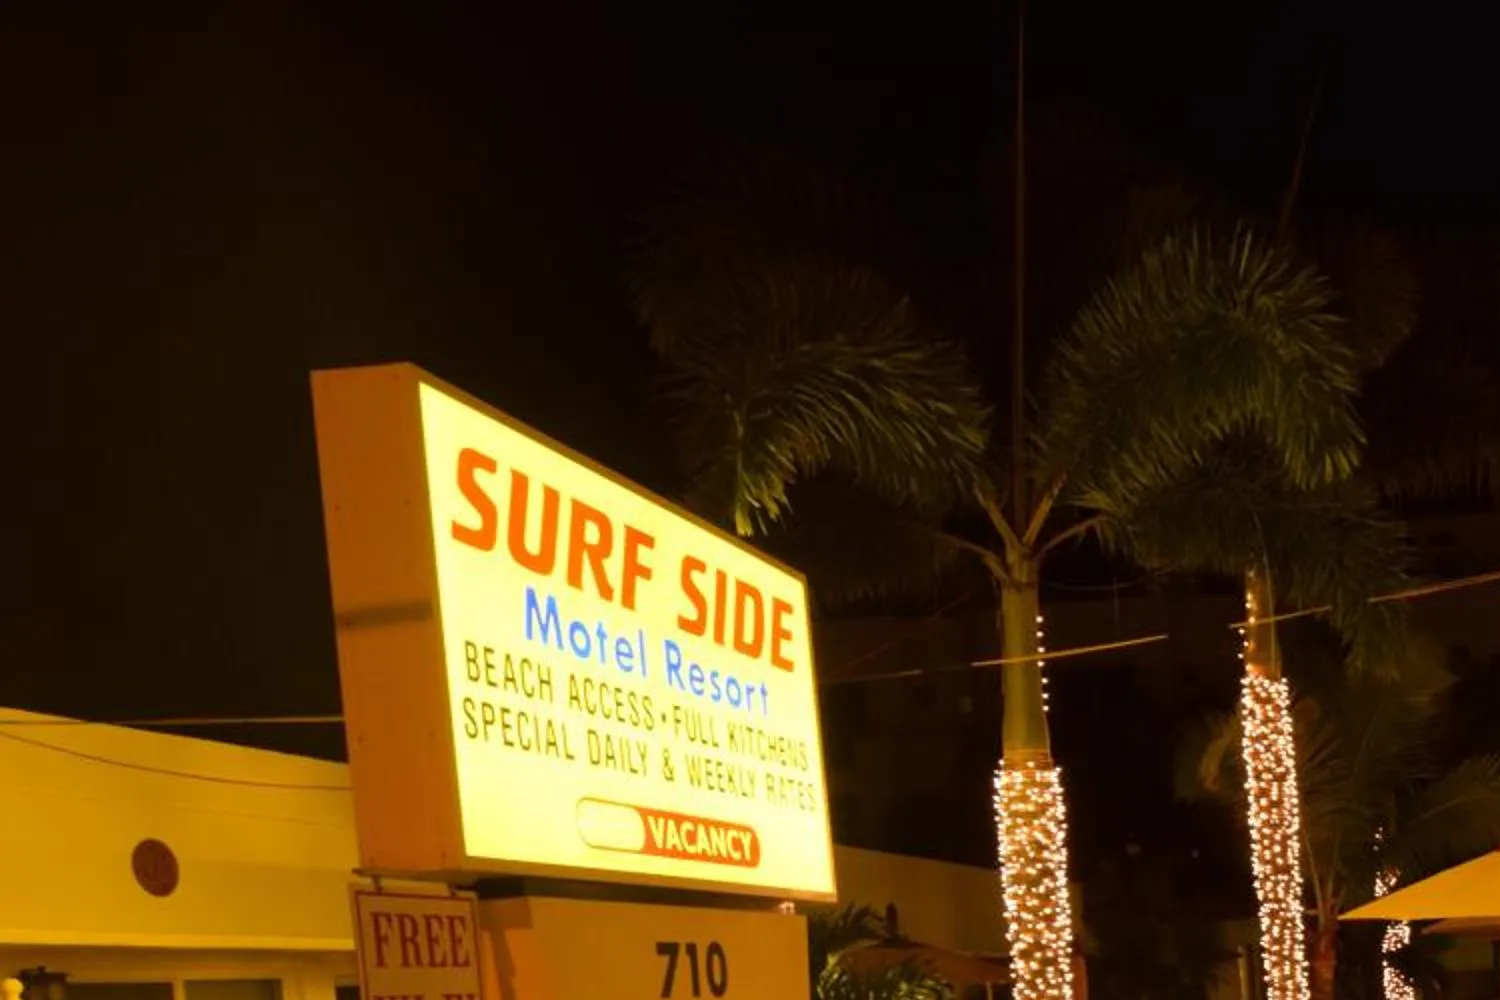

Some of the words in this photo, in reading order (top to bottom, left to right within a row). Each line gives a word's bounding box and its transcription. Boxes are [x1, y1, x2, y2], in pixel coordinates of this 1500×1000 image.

[451, 447, 656, 612] SURF
[677, 554, 796, 673] SIDE
[465, 640, 554, 704] BEACH
[727, 720, 810, 772] KITCHENS
[524, 585, 649, 678] Motel
[664, 639, 769, 716] Resort
[463, 697, 576, 762] SPECIAL
[587, 729, 649, 777] DAILY
[662, 748, 676, 783] &
[685, 755, 757, 800] WEEKLY
[765, 771, 818, 813] RATES
[647, 815, 754, 860] VACANCY
[370, 911, 471, 969] FREE
[655, 941, 730, 999] 710
